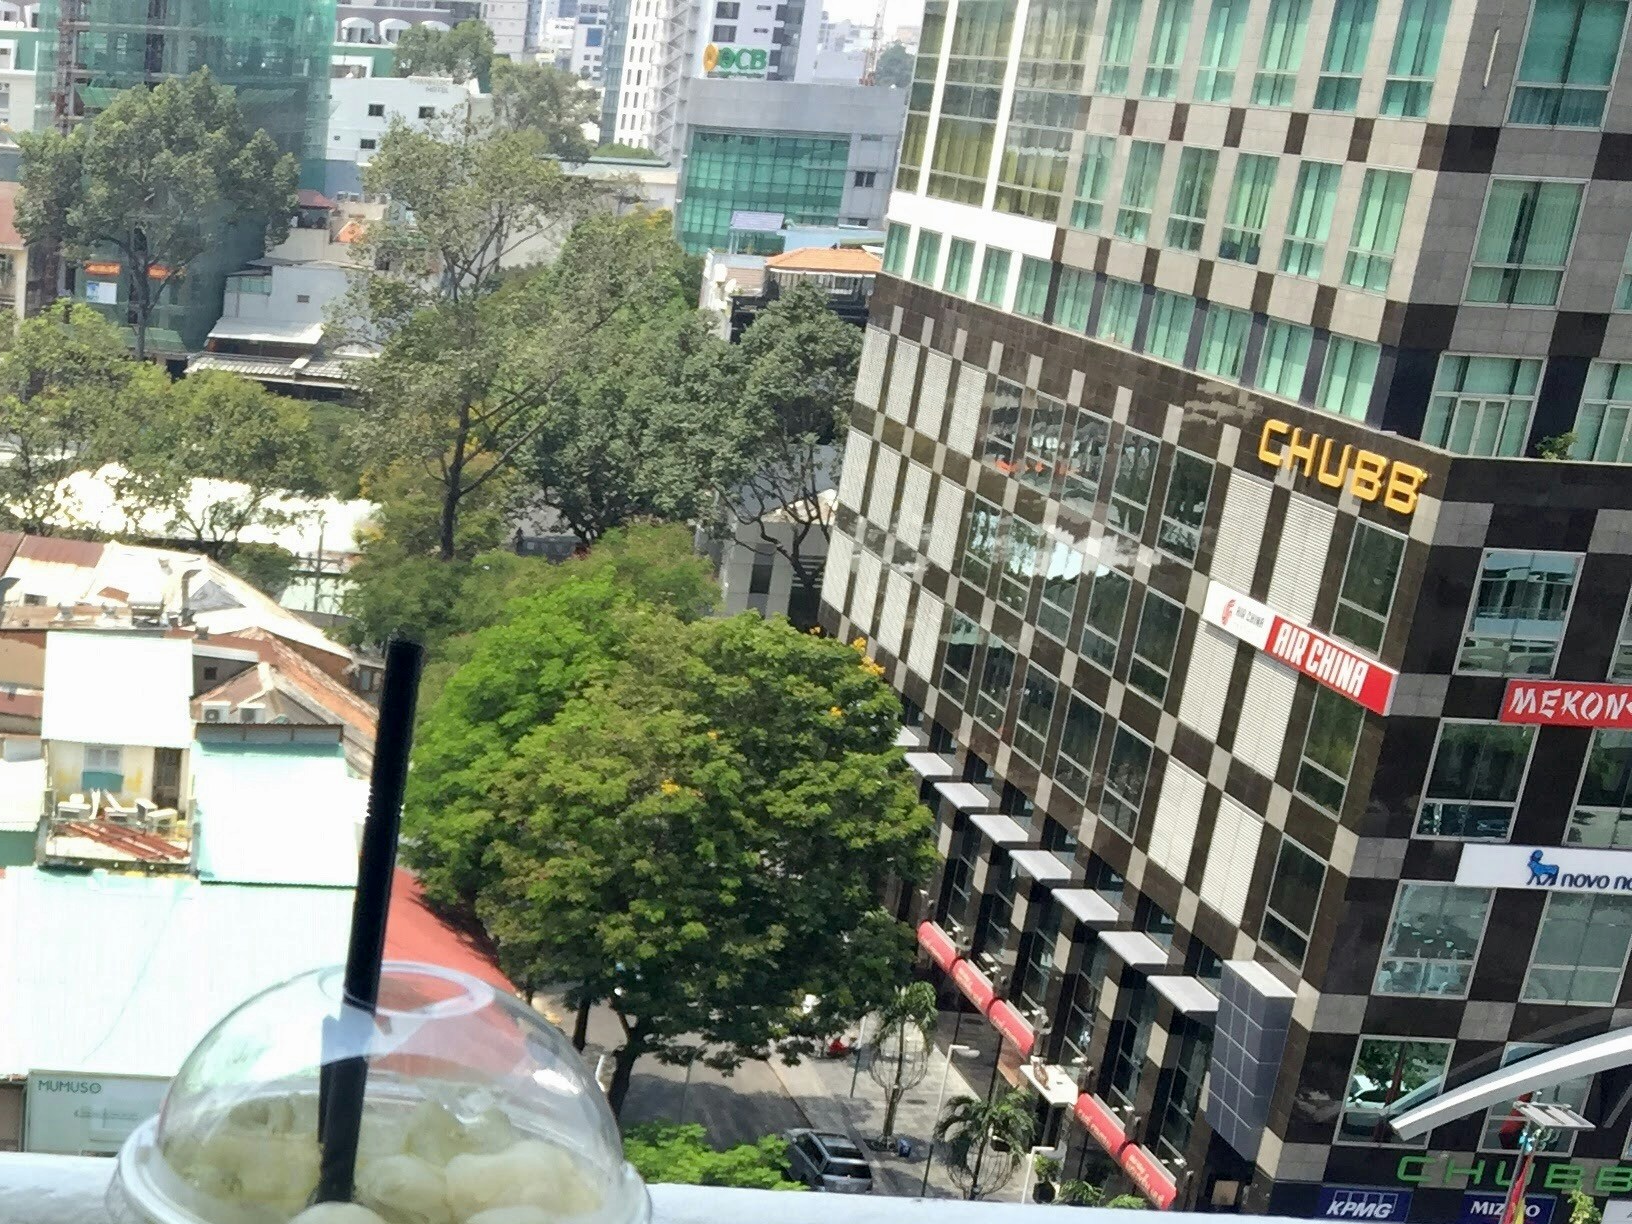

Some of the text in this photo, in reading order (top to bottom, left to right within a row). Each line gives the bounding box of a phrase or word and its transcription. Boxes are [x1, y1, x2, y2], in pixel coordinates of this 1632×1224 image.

[718, 47, 767, 70] OCB
[1258, 418, 1426, 514] CHUBB
[1272, 622, 1369, 698] AIR CHINA
[1509, 686, 1632, 721] MEKON
[1560, 873, 1611, 889] novo
[37, 1079, 102, 1094] MUMUSO
[1396, 1155, 1632, 1193] CHUBB
[1326, 1198, 1396, 1219] KPMG
[1470, 1200, 1541, 1218] MIZO
